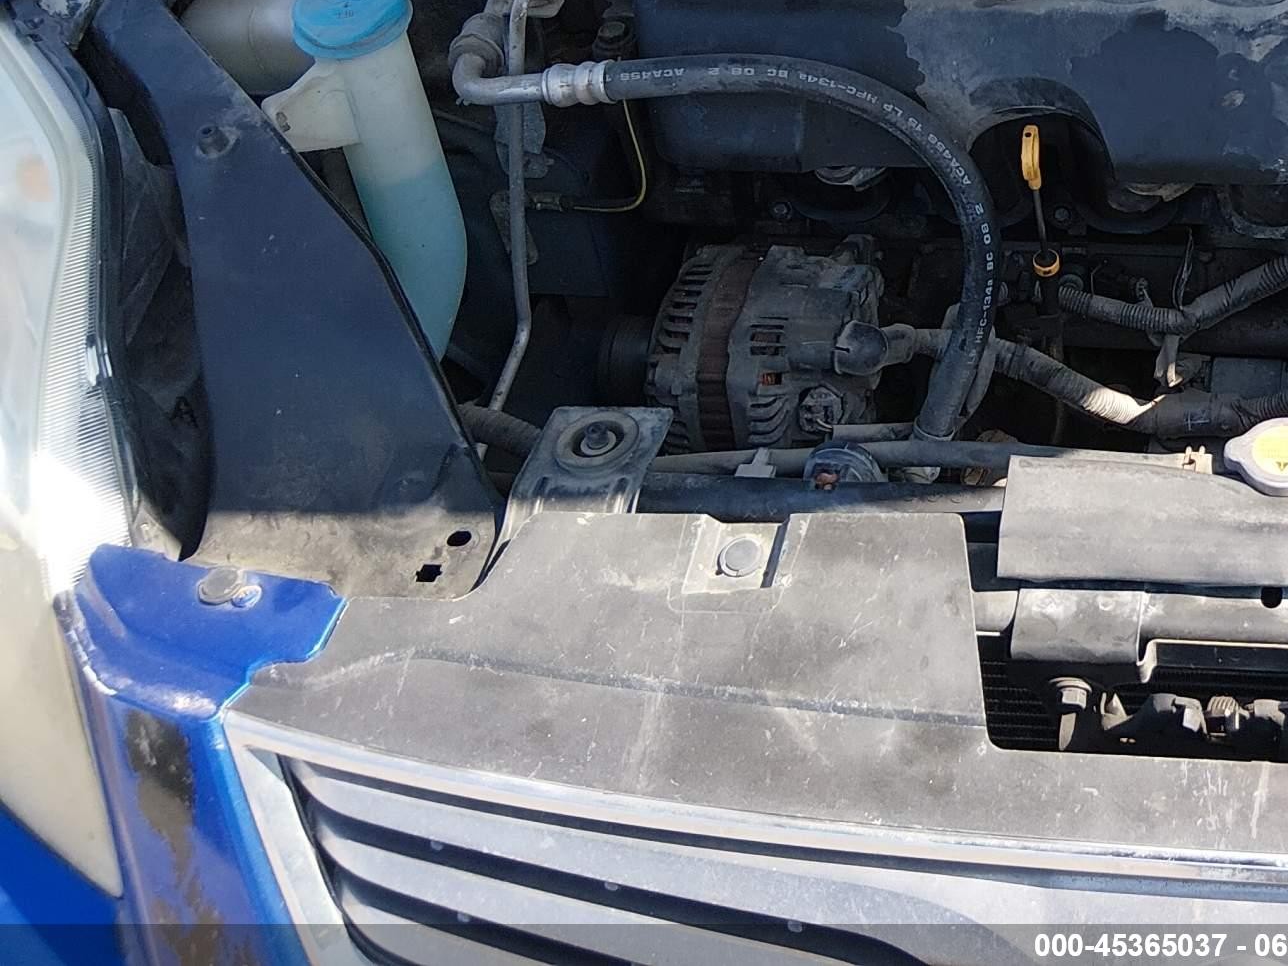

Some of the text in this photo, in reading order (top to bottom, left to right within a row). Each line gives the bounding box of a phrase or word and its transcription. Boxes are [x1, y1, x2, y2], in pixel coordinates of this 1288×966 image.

[708, 67, 720, 76] 2
[767, 68, 788, 78] BC
[882, 103, 903, 117] LP
[975, 203, 984, 215] 2
